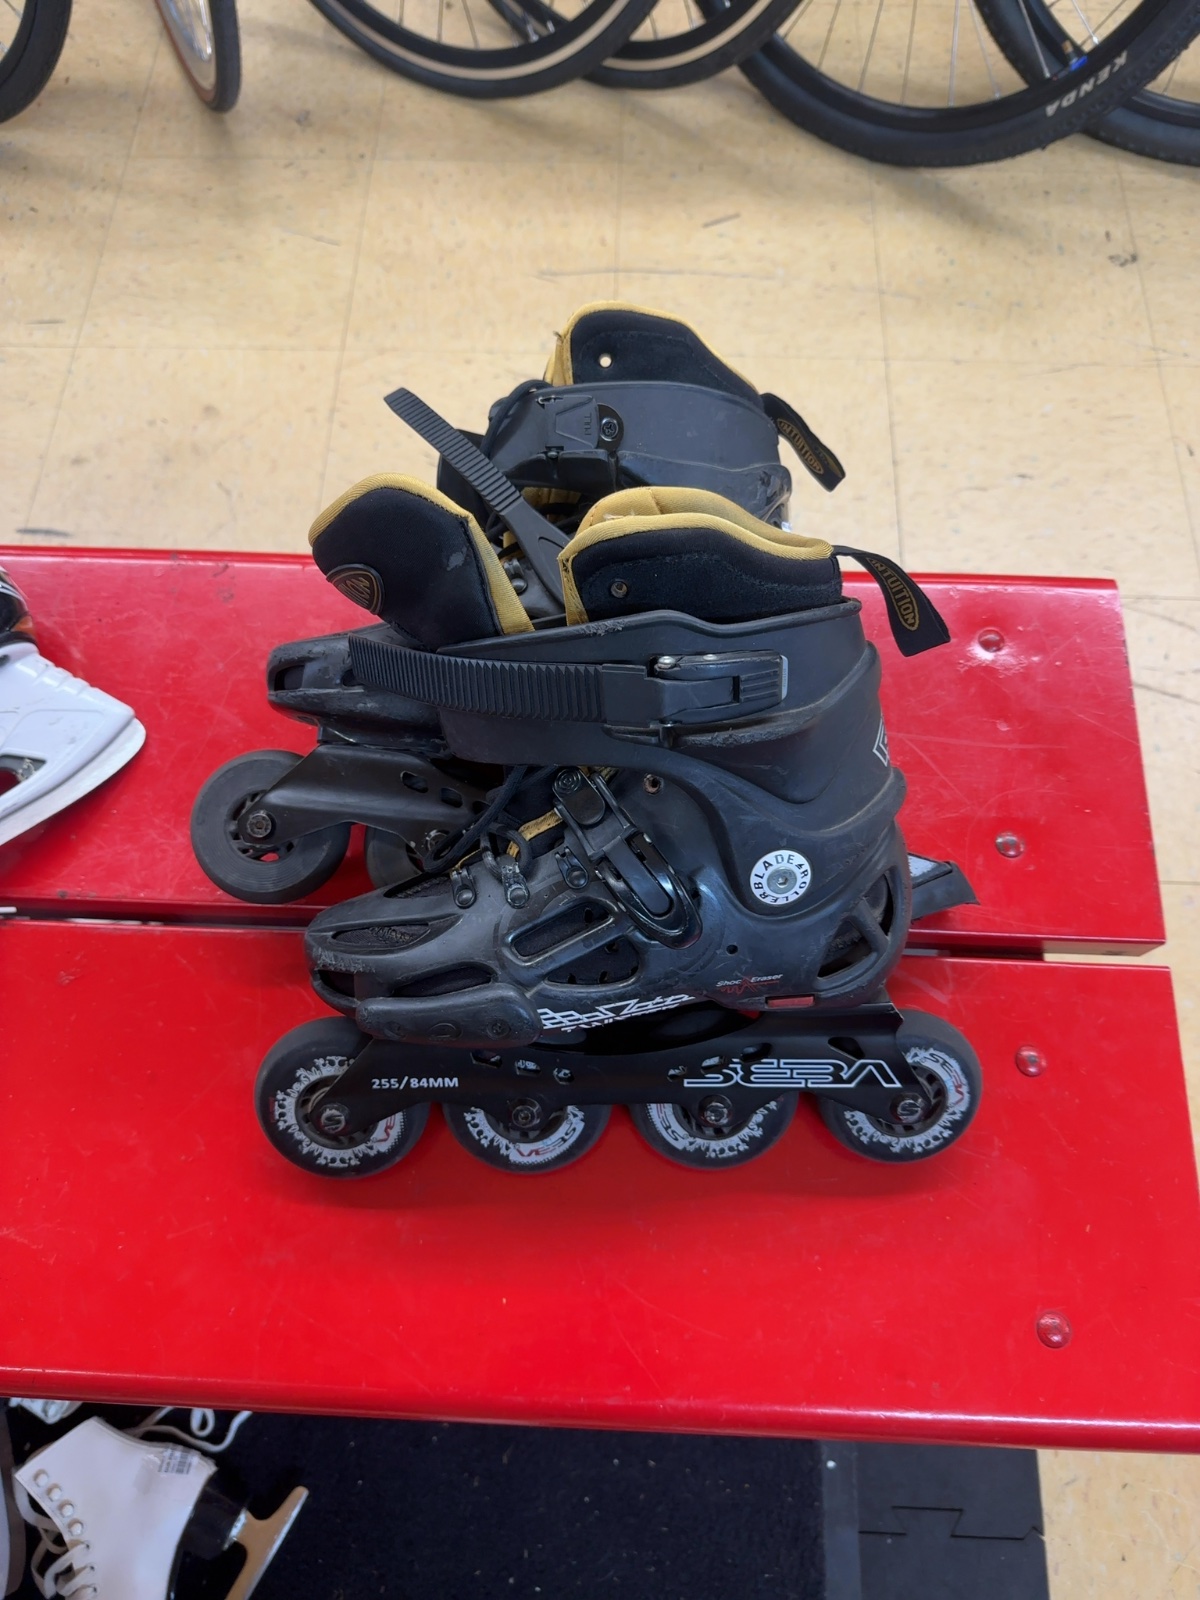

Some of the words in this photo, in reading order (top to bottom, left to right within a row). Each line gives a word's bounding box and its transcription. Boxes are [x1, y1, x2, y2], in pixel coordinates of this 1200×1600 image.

[1046, 50, 1128, 117] KENDA
[779, 421, 822, 473] INTUITION
[868, 558, 917, 626] INTUITION
[750, 974, 784, 983] Eraser
[371, 1076, 459, 1090] 255/84MM
